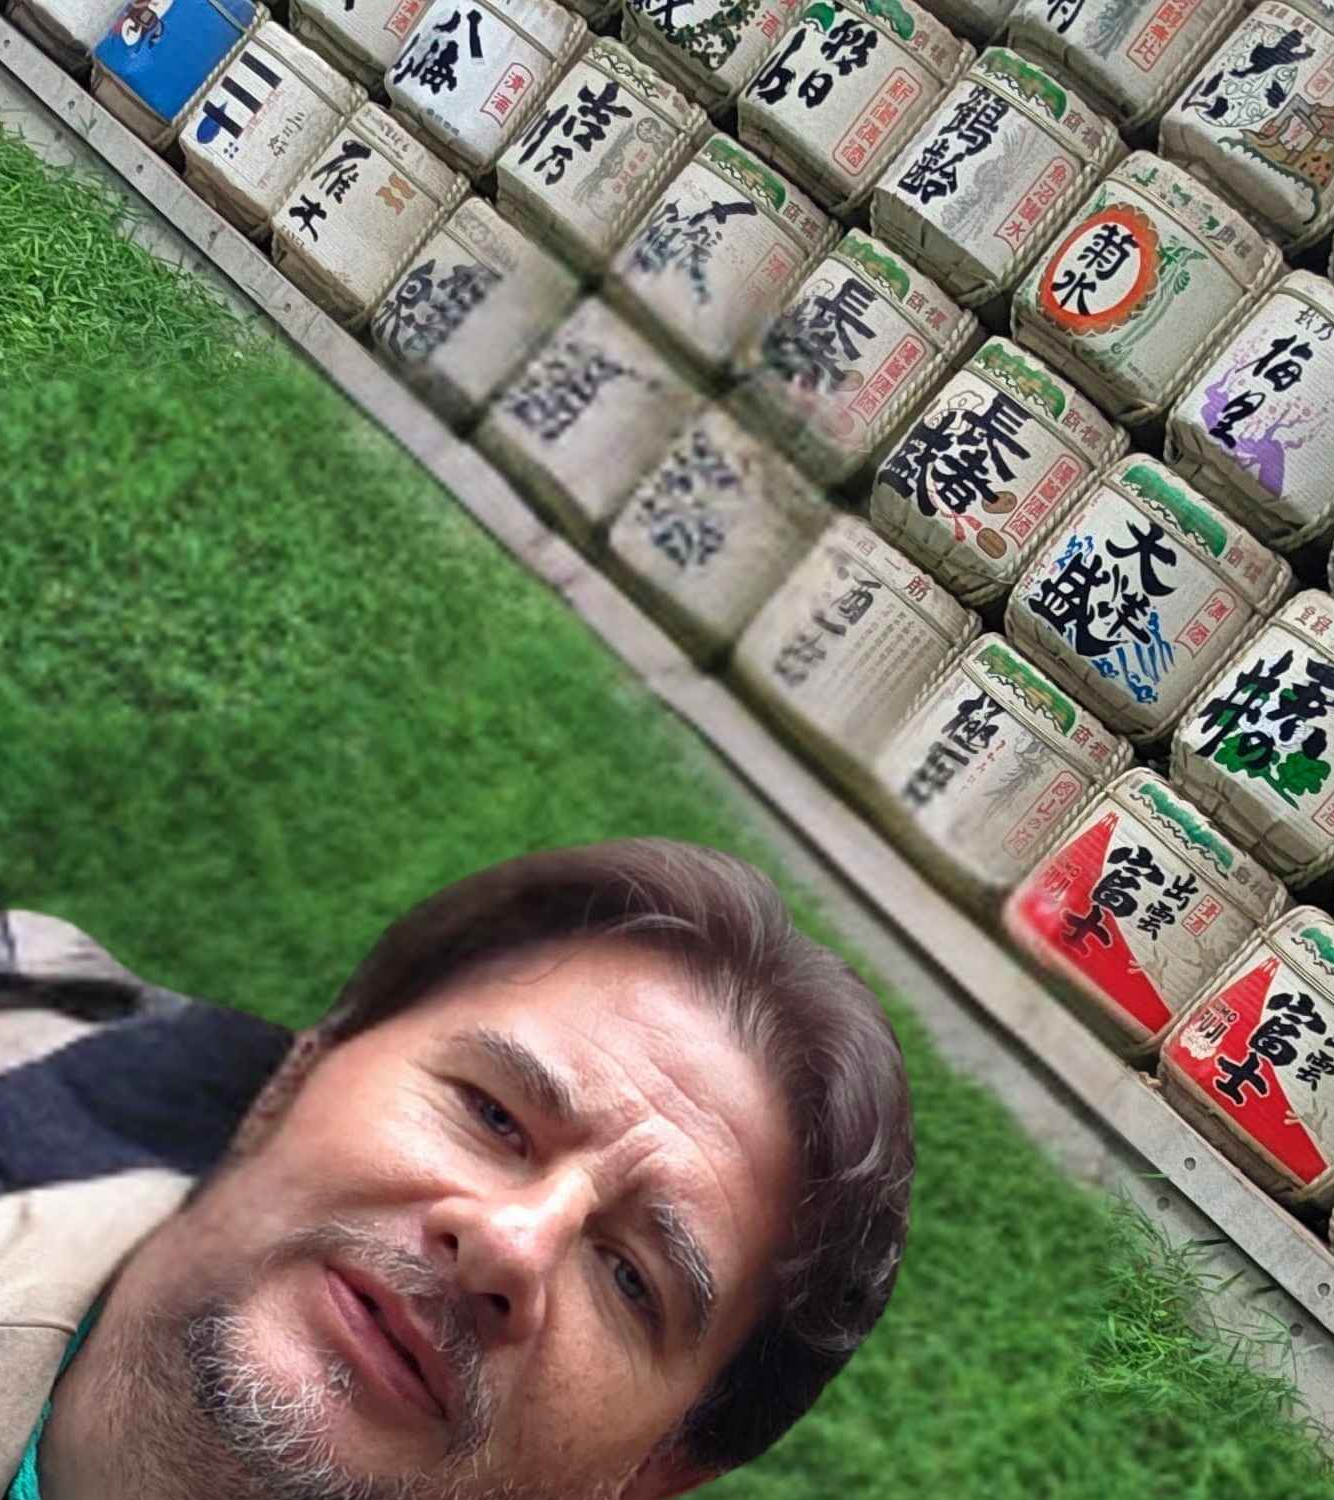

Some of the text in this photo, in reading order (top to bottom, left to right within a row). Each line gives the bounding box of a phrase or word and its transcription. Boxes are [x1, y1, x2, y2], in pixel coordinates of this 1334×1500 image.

[485, 72, 533, 115] 清酒
[290, 142, 371, 241] 雁木
[1052, 225, 1137, 315] 菊水
[1209, 335, 1312, 448] 梅里
[1074, 847, 1198, 943] 出雲 富士
[1217, 993, 1326, 1104] 富士
